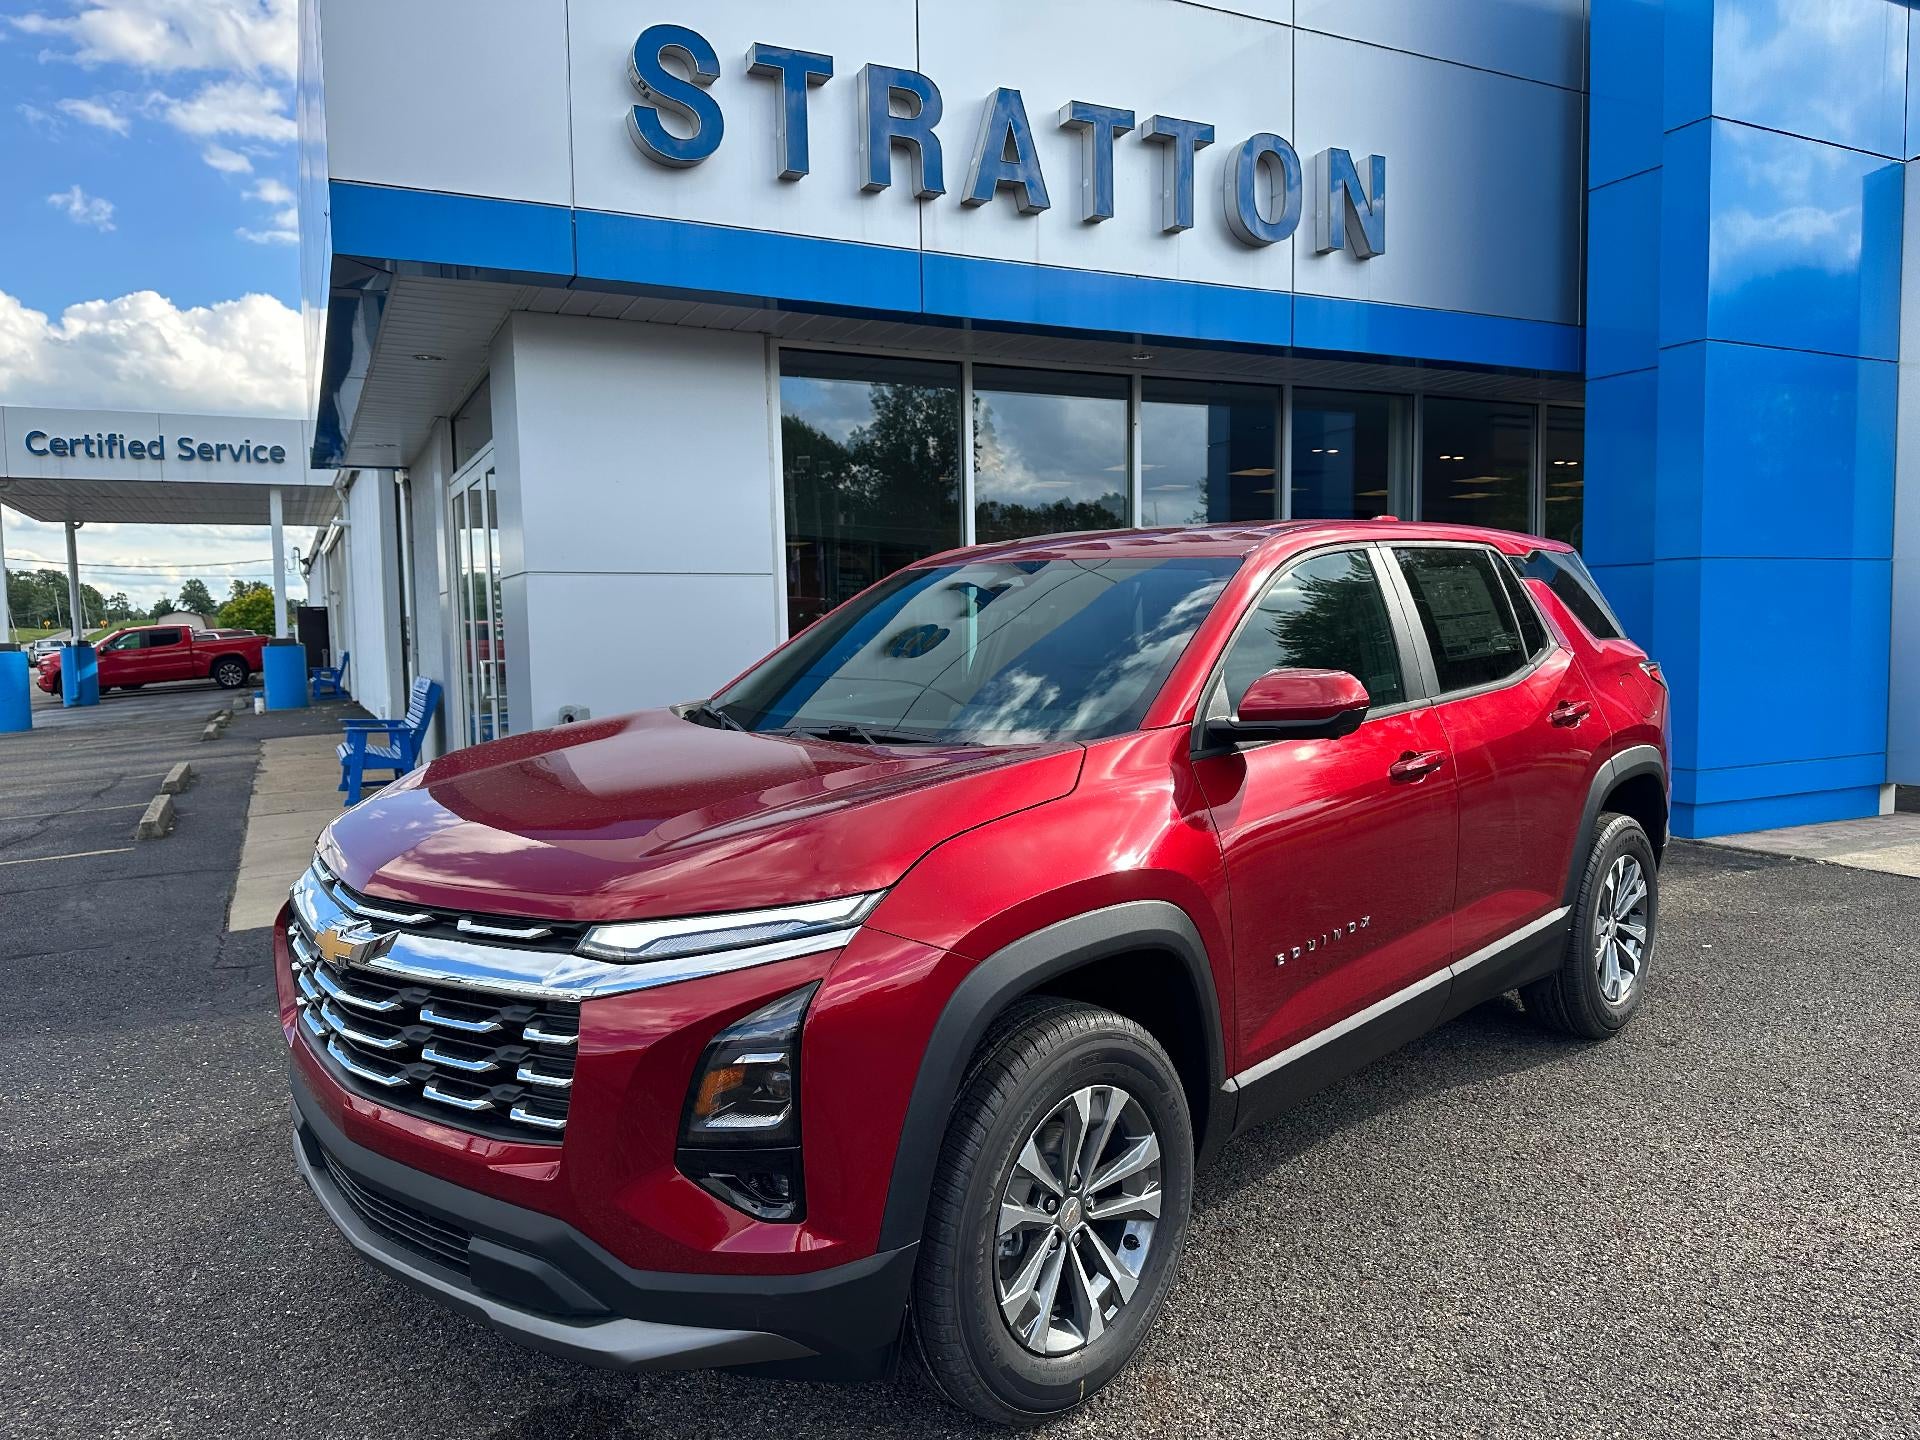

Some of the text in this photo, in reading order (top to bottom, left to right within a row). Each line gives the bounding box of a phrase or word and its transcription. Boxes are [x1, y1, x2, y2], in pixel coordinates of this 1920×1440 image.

[627, 24, 1386, 257] STRATTON
[25, 430, 286, 464] Certified Service
[1275, 915, 1370, 966] EQUINOX
